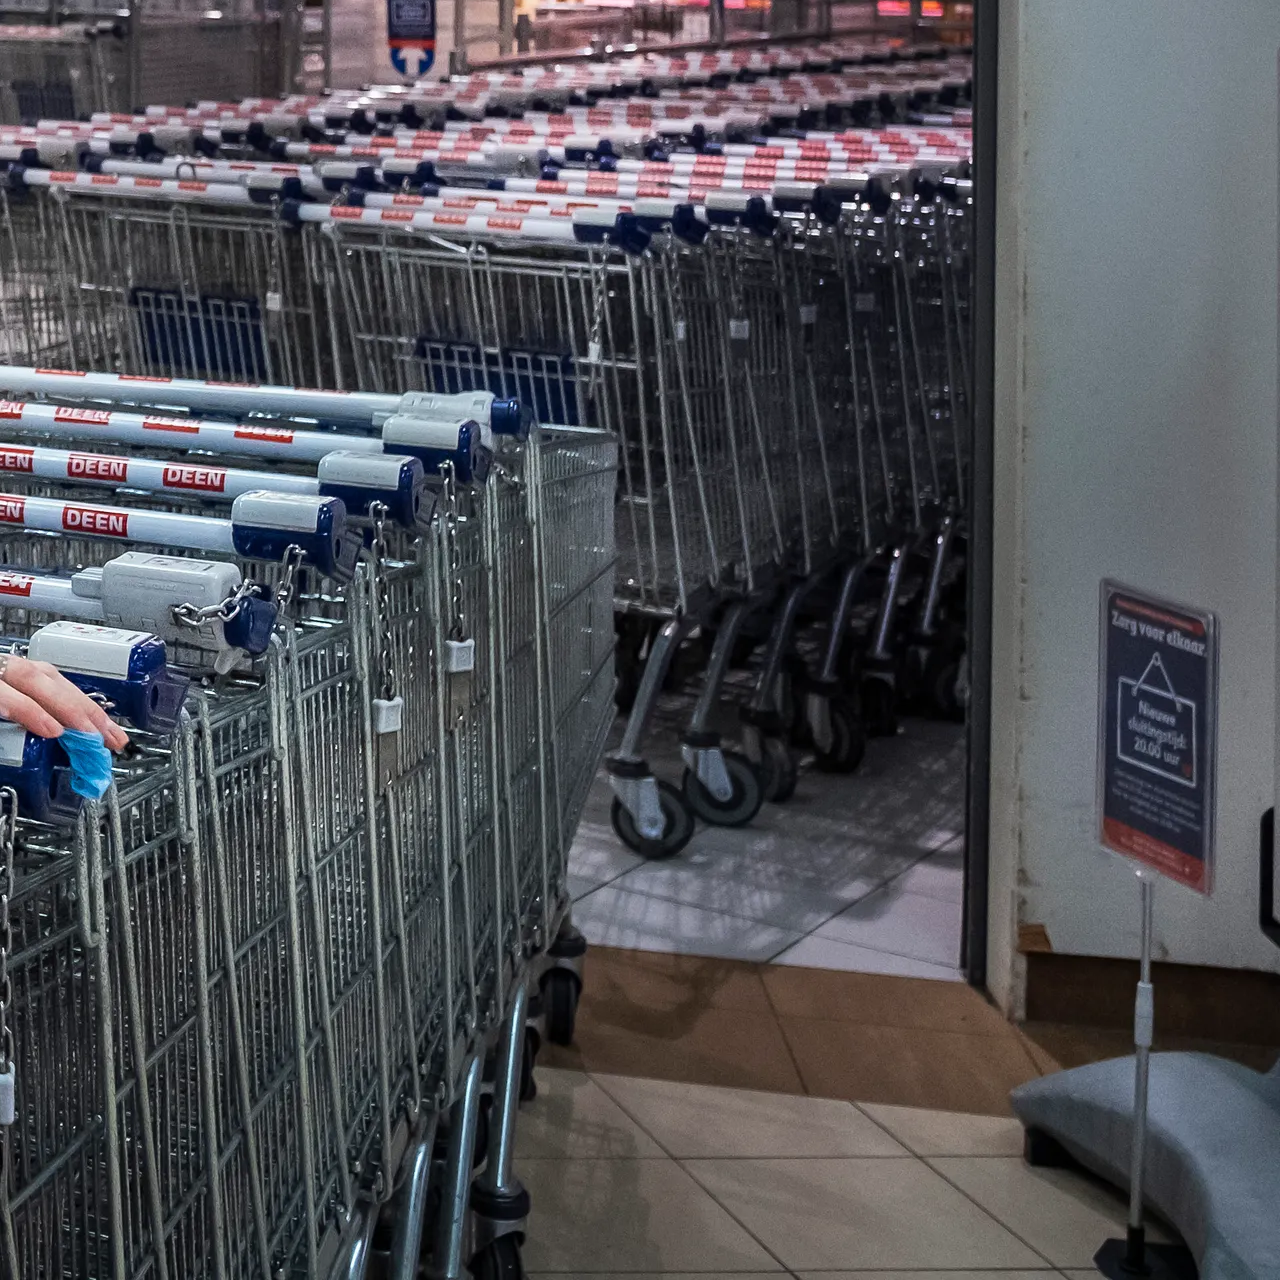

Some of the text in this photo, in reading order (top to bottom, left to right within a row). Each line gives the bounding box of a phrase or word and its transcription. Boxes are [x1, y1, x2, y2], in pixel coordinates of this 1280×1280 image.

[70, 459, 126, 477] DEEN
[166, 468, 226, 488] DEEN
[66, 510, 127, 533] DEEN
[1112, 611, 1137, 636] Zorg
[1139, 621, 1165, 643] voor
[1138, 699, 1177, 727] Nieuwe
[1163, 751, 1181, 765] uur
